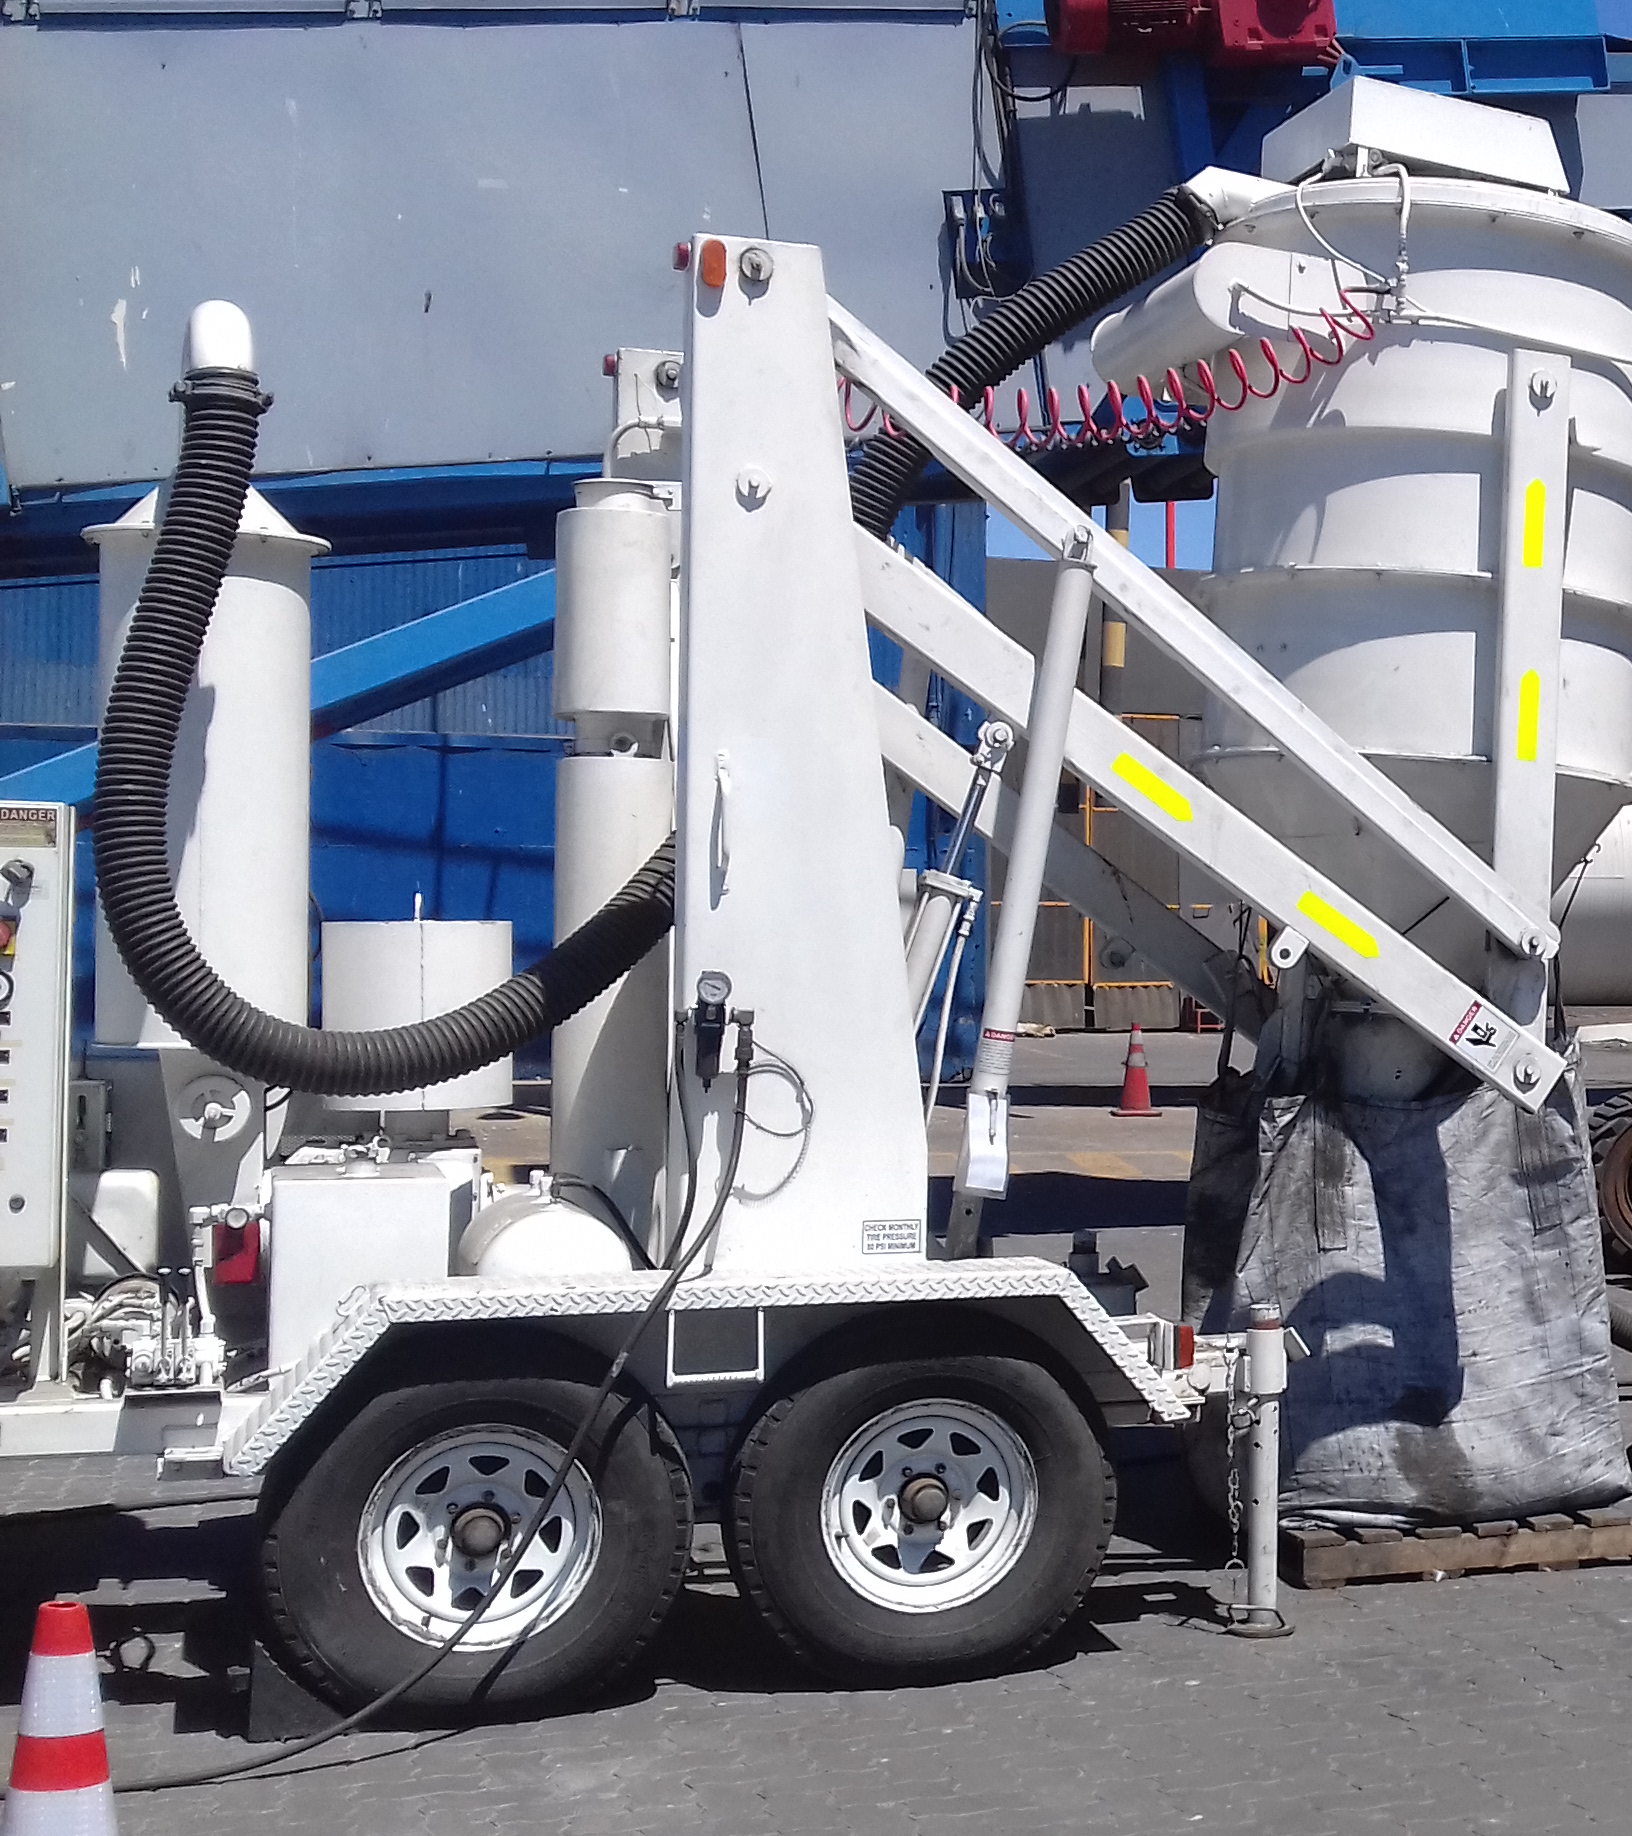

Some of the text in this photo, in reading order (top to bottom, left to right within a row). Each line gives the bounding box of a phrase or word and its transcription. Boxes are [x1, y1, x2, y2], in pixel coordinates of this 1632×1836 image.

[0, 808, 56, 821] DANGER
[864, 1222, 919, 1232] CHECK MONTHLY
[882, 1232, 917, 1241] PRESSURE
[887, 1241, 916, 1250] MINIMUM
